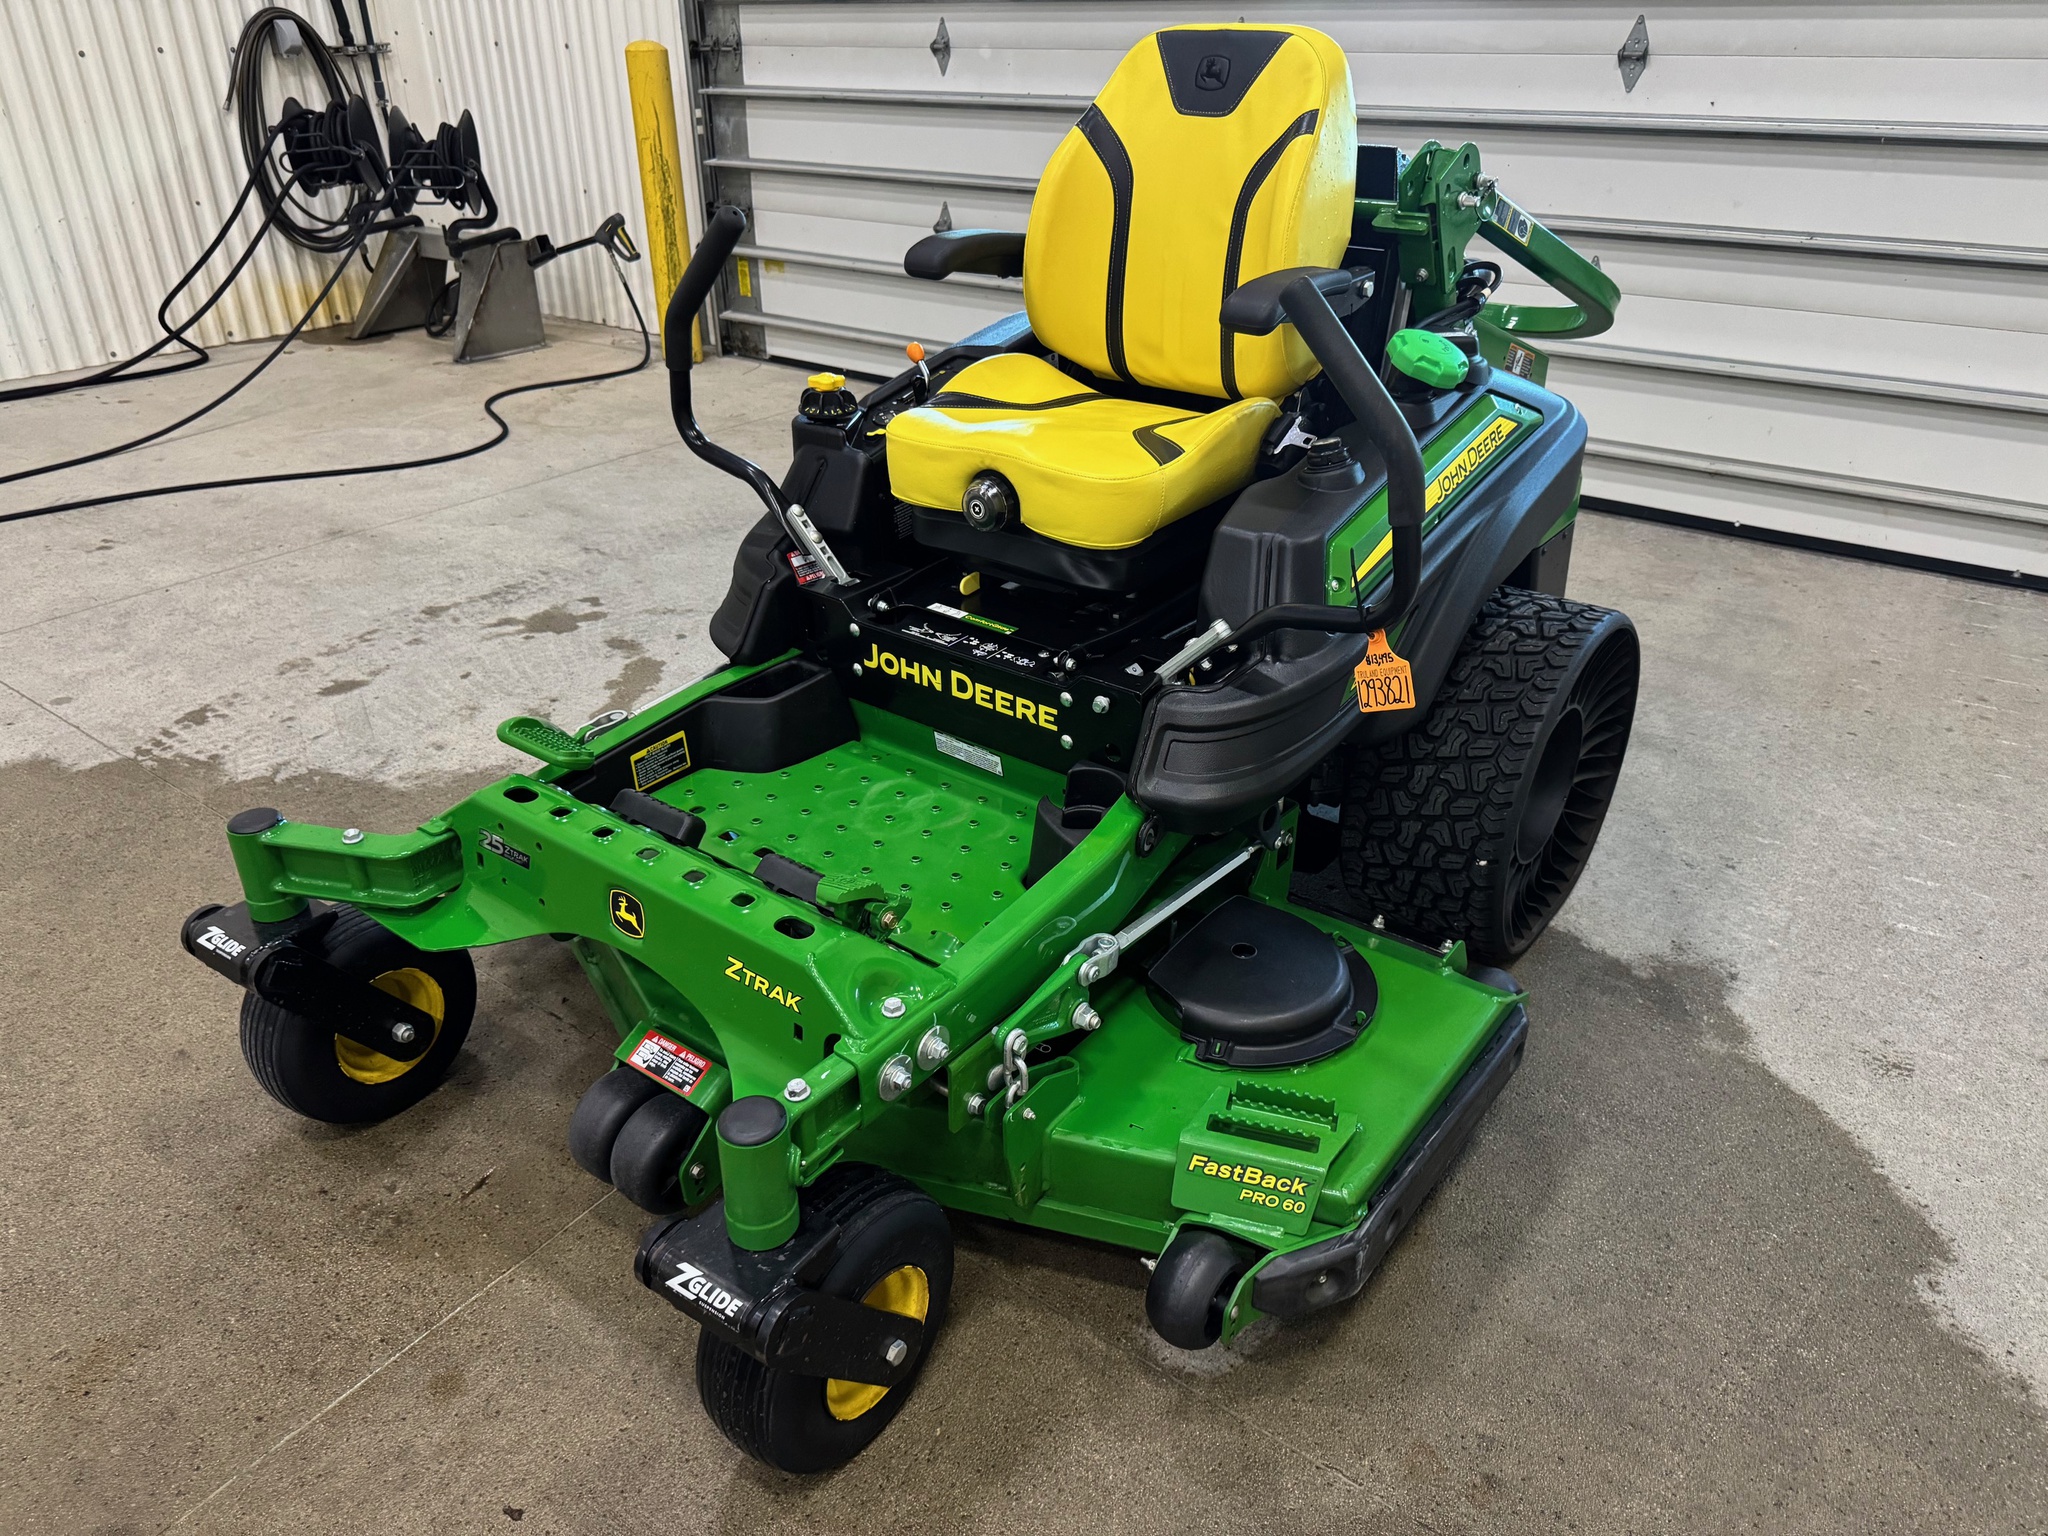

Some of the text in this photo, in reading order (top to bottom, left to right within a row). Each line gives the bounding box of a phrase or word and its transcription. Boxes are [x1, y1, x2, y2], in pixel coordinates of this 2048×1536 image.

[1437, 423, 1505, 501] JOHN DEERE
[1379, 664, 1407, 677] EQUIPMENT
[863, 643, 1059, 732] JOHN DEERE
[1357, 675, 1411, 709] 1293821
[479, 829, 504, 855] 25
[504, 845, 529, 863] ZTRAK
[196, 925, 247, 957] ZGLIDE
[724, 955, 802, 1013] ZTRAK
[684, 1051, 707, 1068] PELIGRO
[1187, 1153, 1308, 1196] FastBack
[1239, 1188, 1306, 1214] PRO 60
[664, 1261, 744, 1318] ZGLIDE
[698, 1300, 726, 1320] SUSPENSION
